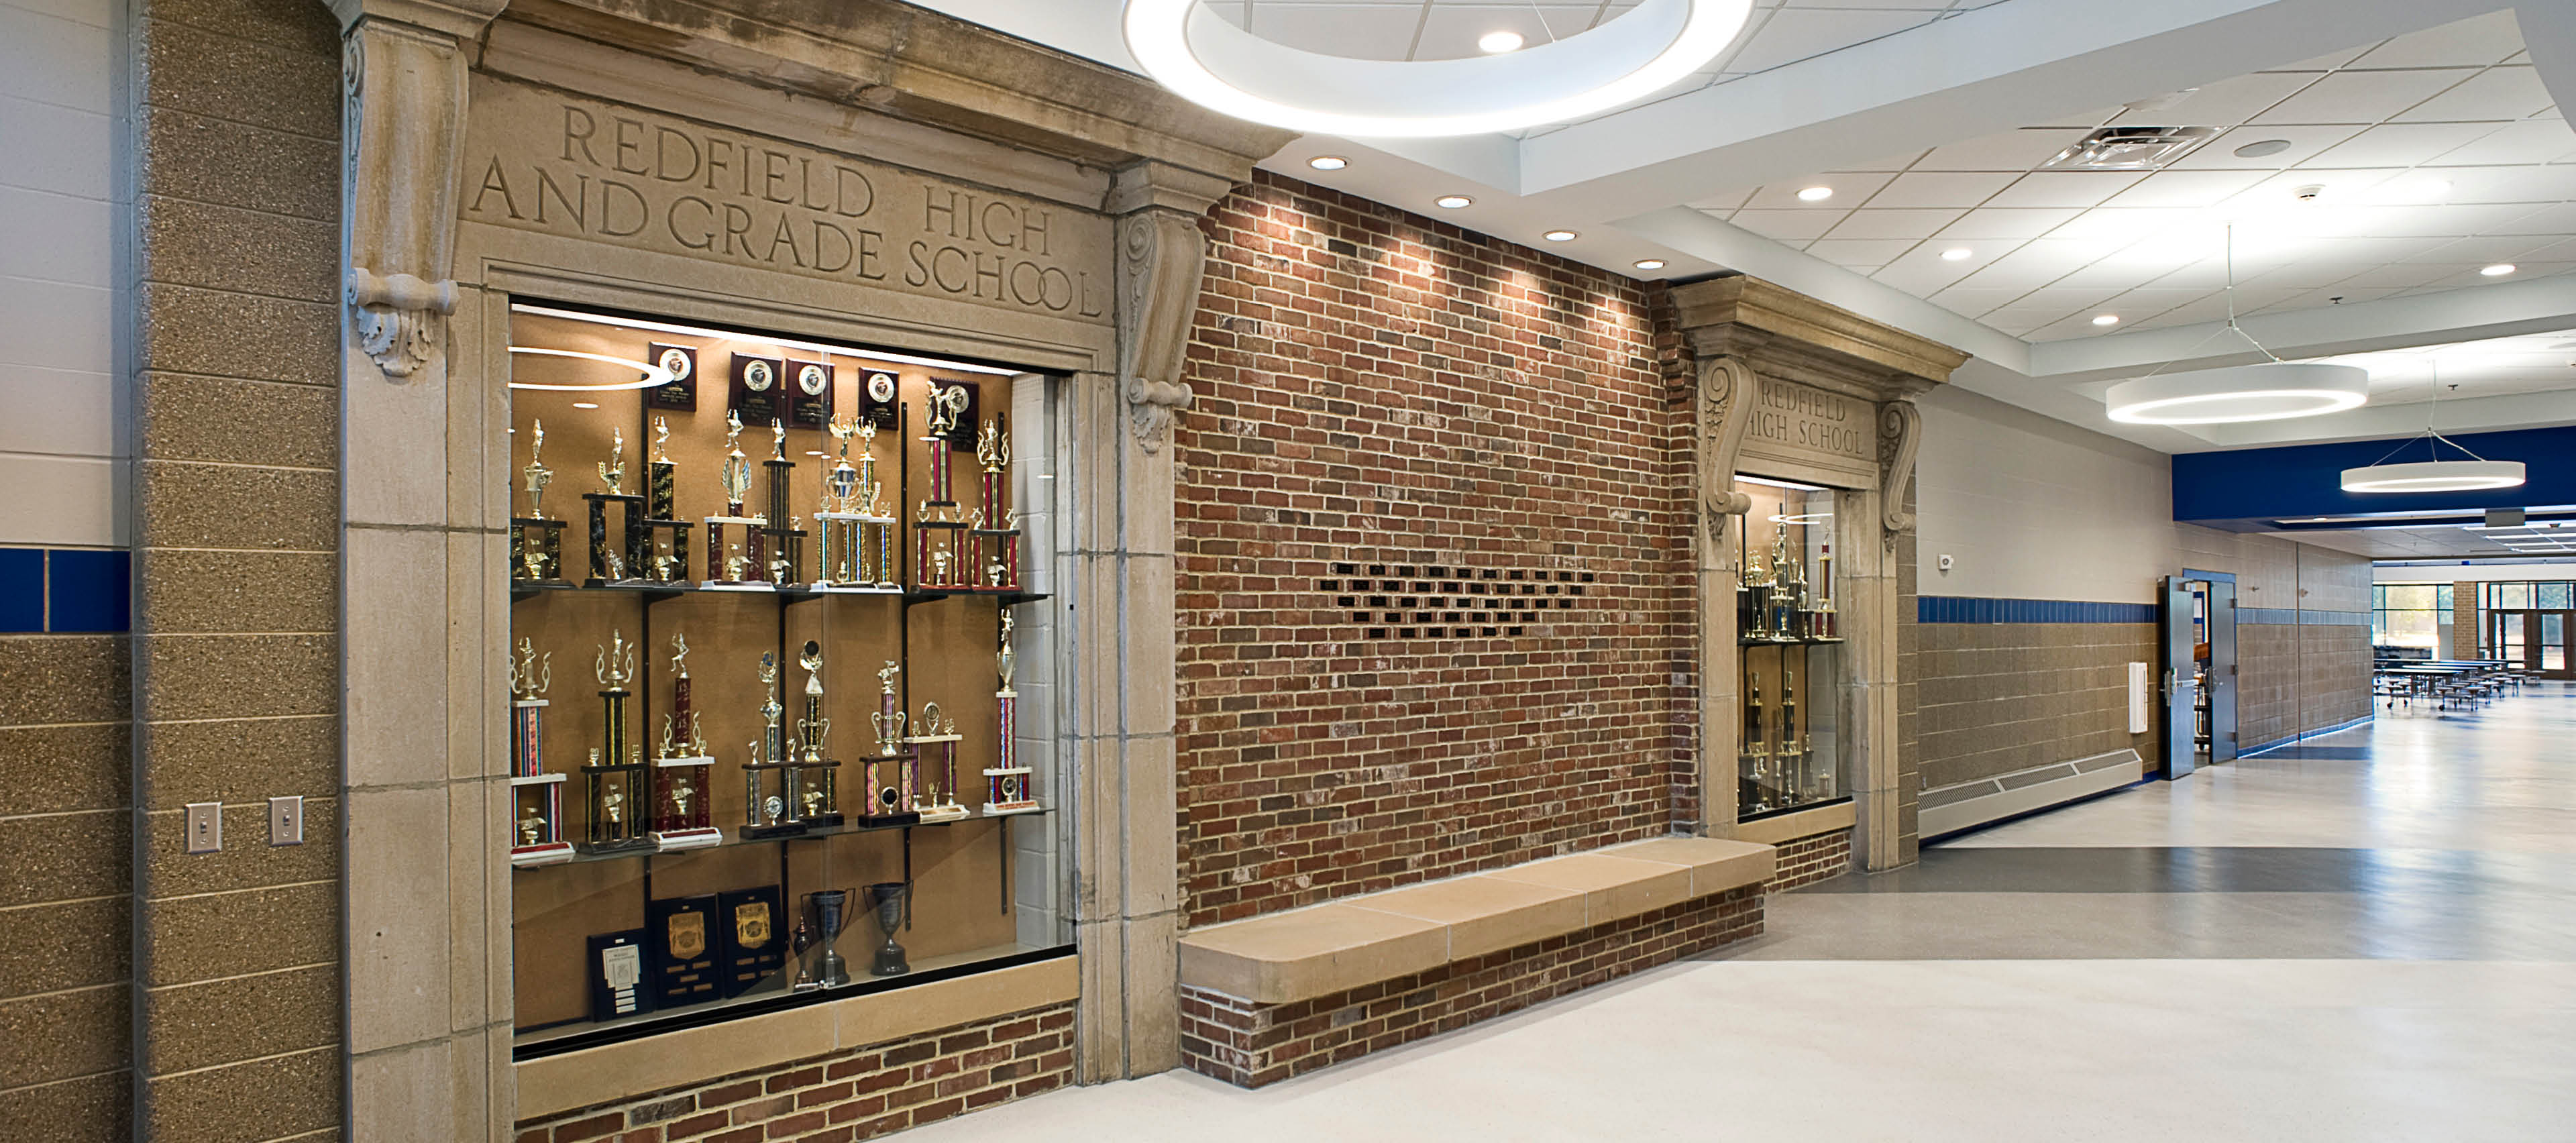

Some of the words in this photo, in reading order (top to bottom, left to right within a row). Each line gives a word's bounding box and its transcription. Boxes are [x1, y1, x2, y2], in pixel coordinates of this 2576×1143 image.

[559, 105, 875, 219] REDFIELD
[924, 184, 1052, 256] HIGH
[469, 154, 649, 237] AND
[667, 195, 886, 282] GRADE
[904, 240, 1102, 319] SCHOOL
[1761, 380, 1845, 422] REDFIELD
[1799, 420, 1863, 455] SCHOOL
